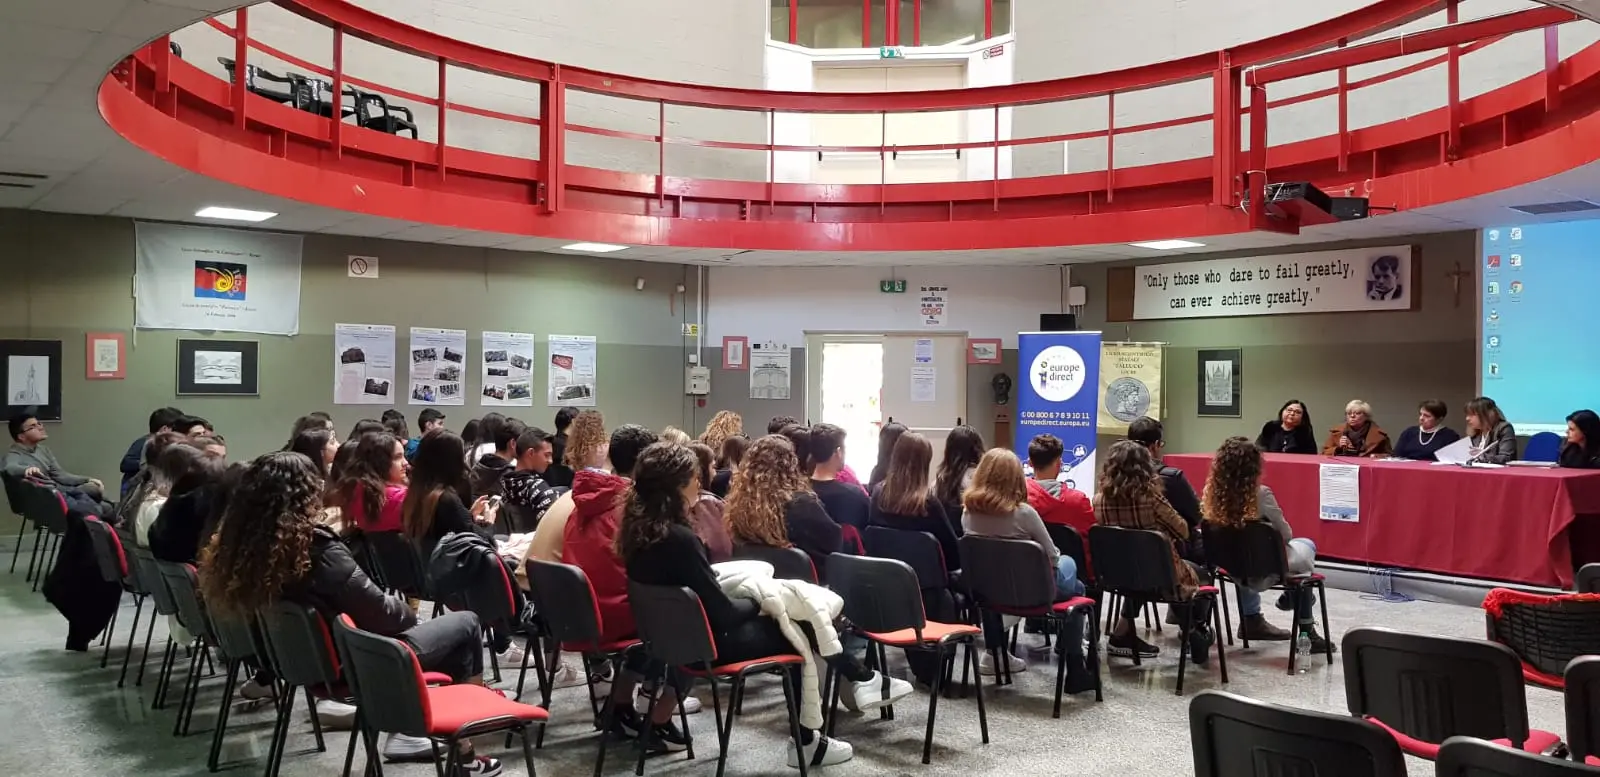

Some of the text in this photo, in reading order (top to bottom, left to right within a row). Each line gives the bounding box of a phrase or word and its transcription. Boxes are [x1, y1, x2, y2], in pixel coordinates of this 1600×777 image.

[1143, 260, 1354, 290] "Only those who dare to fail greatly,
[1170, 287, 1320, 309] can ever achieve greatly."
[1049, 364, 1080, 373] europe
[1049, 371, 1074, 381] direct
[1020, 419, 1090, 427] europedirect.europa.eu
